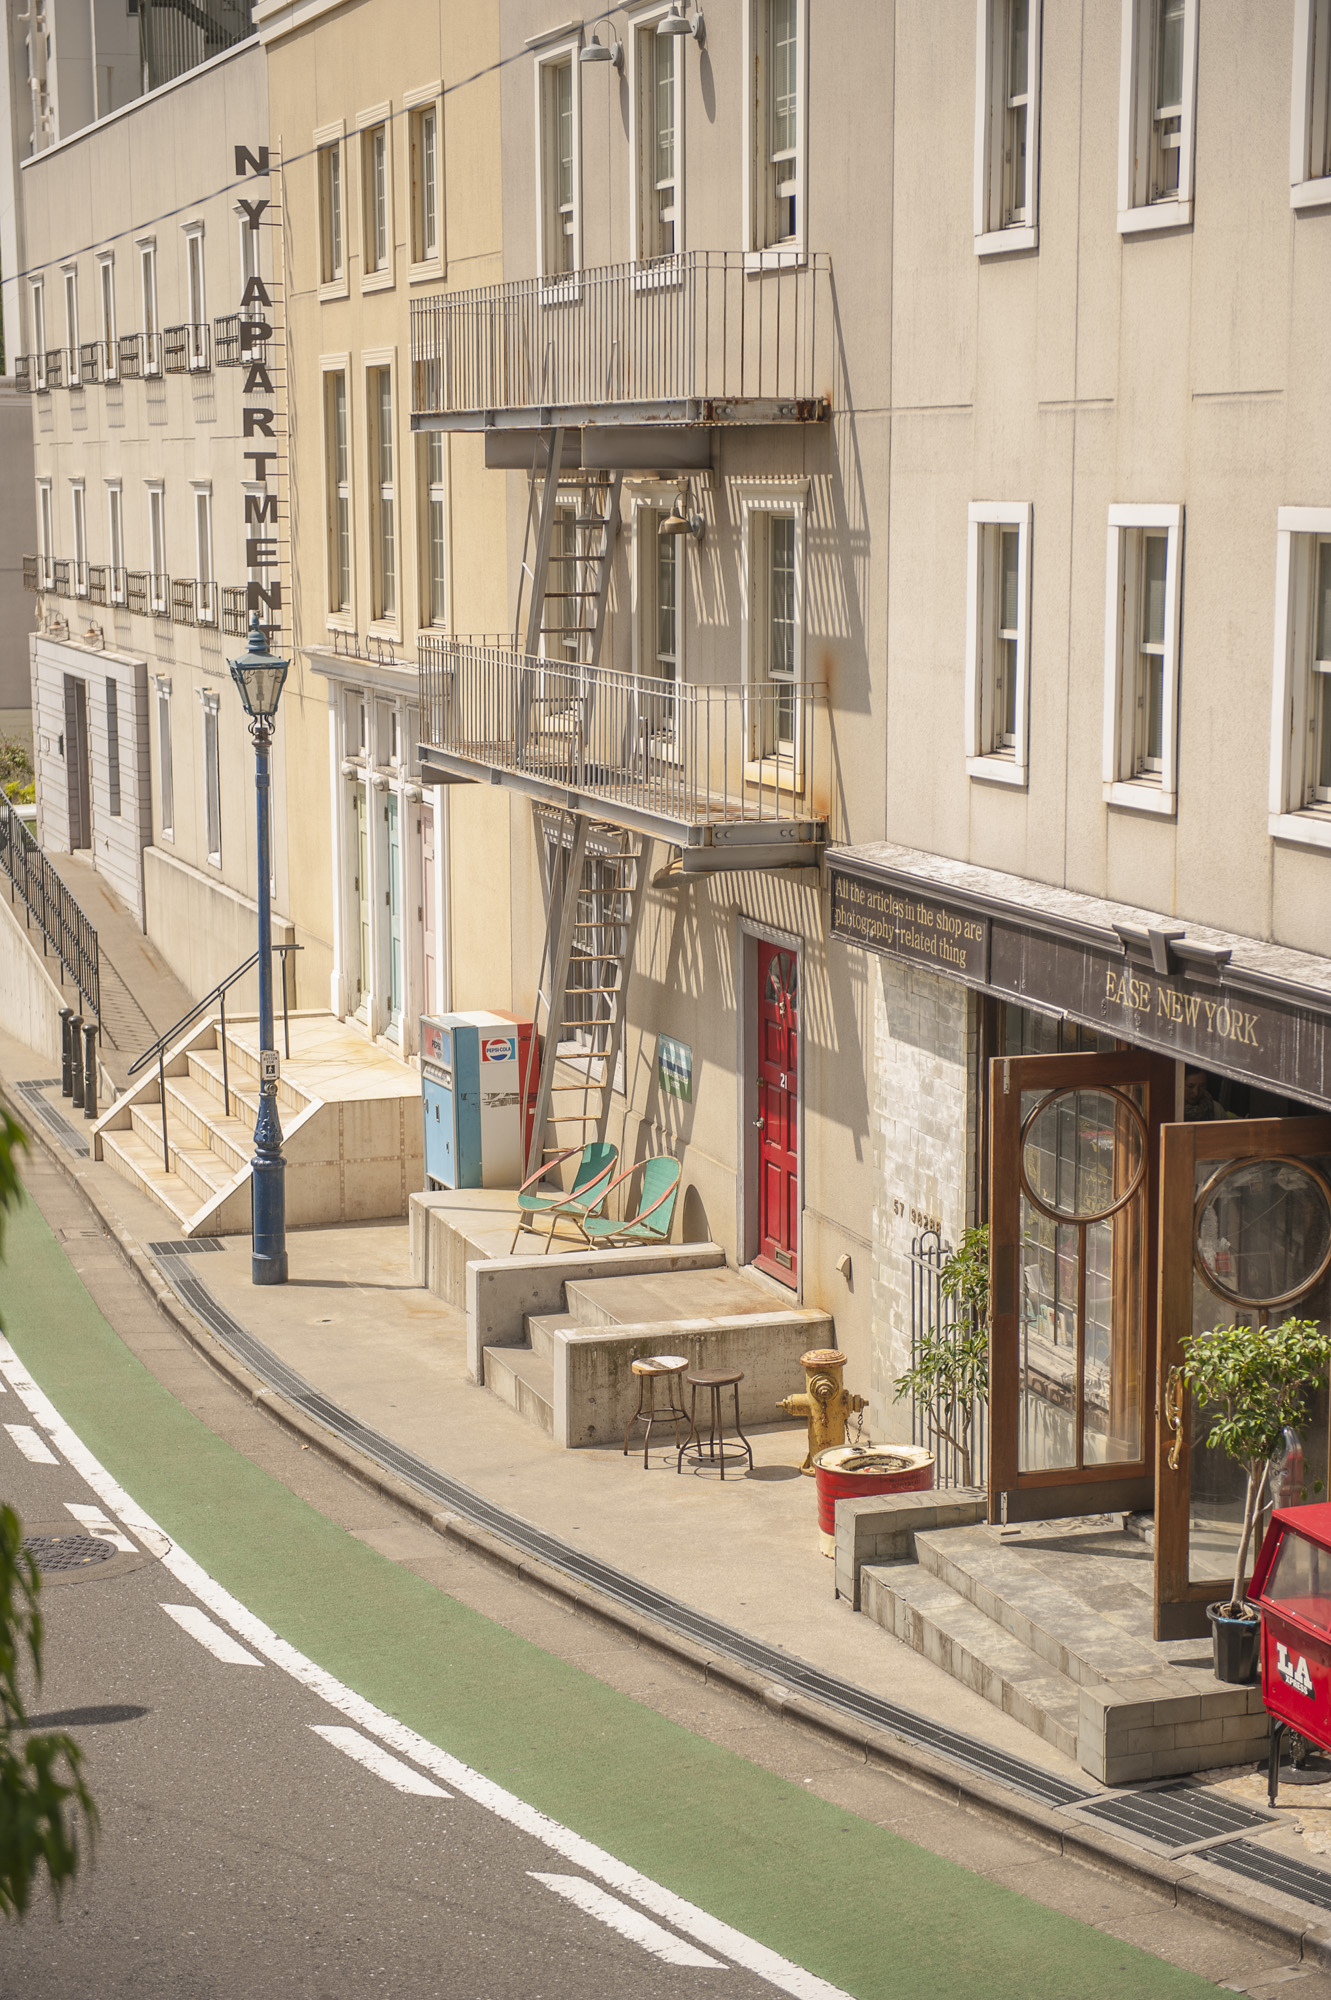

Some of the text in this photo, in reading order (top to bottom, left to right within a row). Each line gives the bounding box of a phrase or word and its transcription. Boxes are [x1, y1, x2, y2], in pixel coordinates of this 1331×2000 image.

[835, 876, 983, 942] All the articles in the shop are
[939, 937, 967, 969] thing
[1105, 971, 1259, 1047] EASE NEW YORK
[431, 1039, 442, 1052] PEPSI
[780, 1072, 788, 1090] 21
[893, 1199, 905, 1218] 57
[1276, 1641, 1313, 1691] LA
[1285, 1674, 1308, 1695] XPRESS
